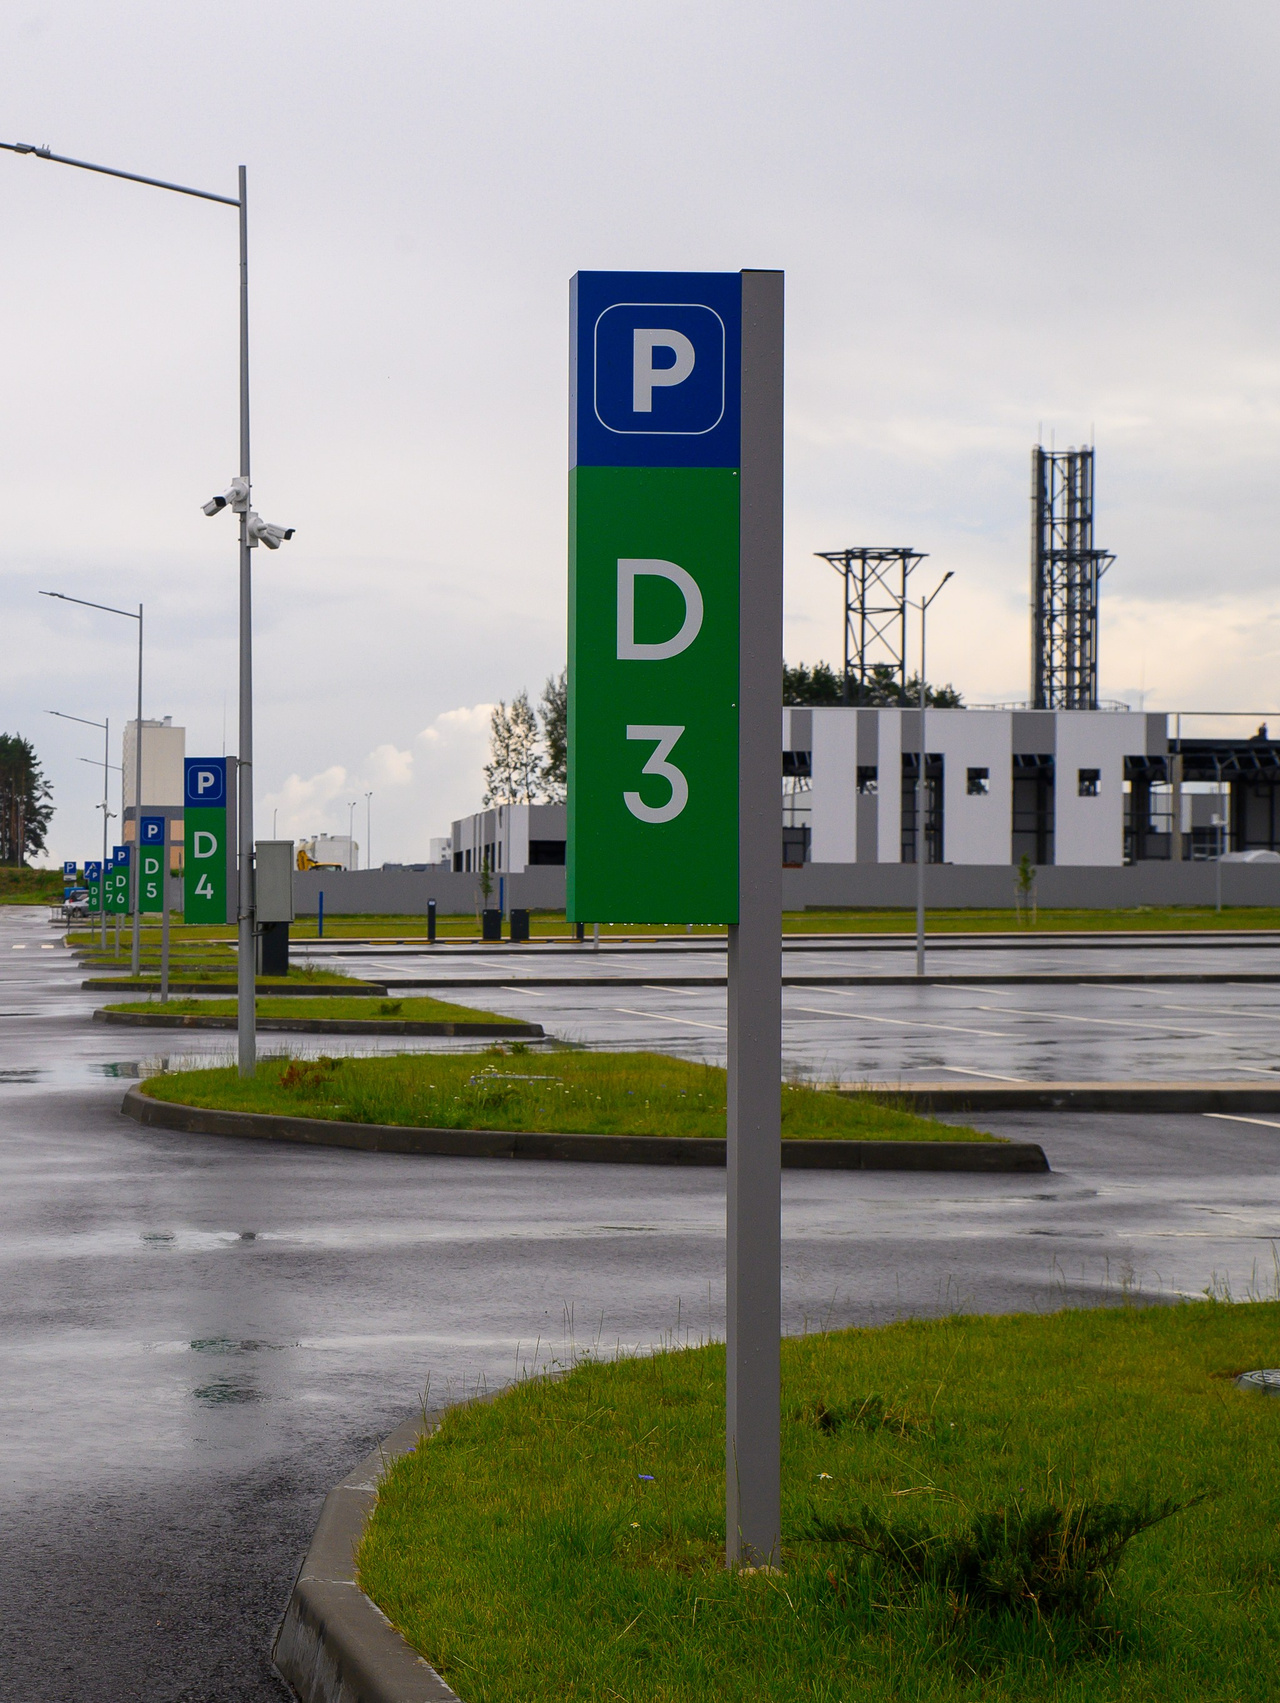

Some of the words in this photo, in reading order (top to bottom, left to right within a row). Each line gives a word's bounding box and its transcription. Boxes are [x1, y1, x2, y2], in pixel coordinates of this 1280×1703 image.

[632, 327, 695, 412] P
[616, 558, 704, 660] D
[623, 724, 689, 824] 3
[197, 771, 215, 794] P
[147, 824, 158, 838] P
[193, 831, 217, 858] D
[117, 851, 125, 861] P
[66, 862, 74, 873] P
[145, 858, 159, 874] D
[116, 875, 126, 887] D
[194, 874, 214, 899] 4
[146, 882, 158, 898] 5
[105, 894, 113, 903] 7
[116, 893, 125, 904] 6
